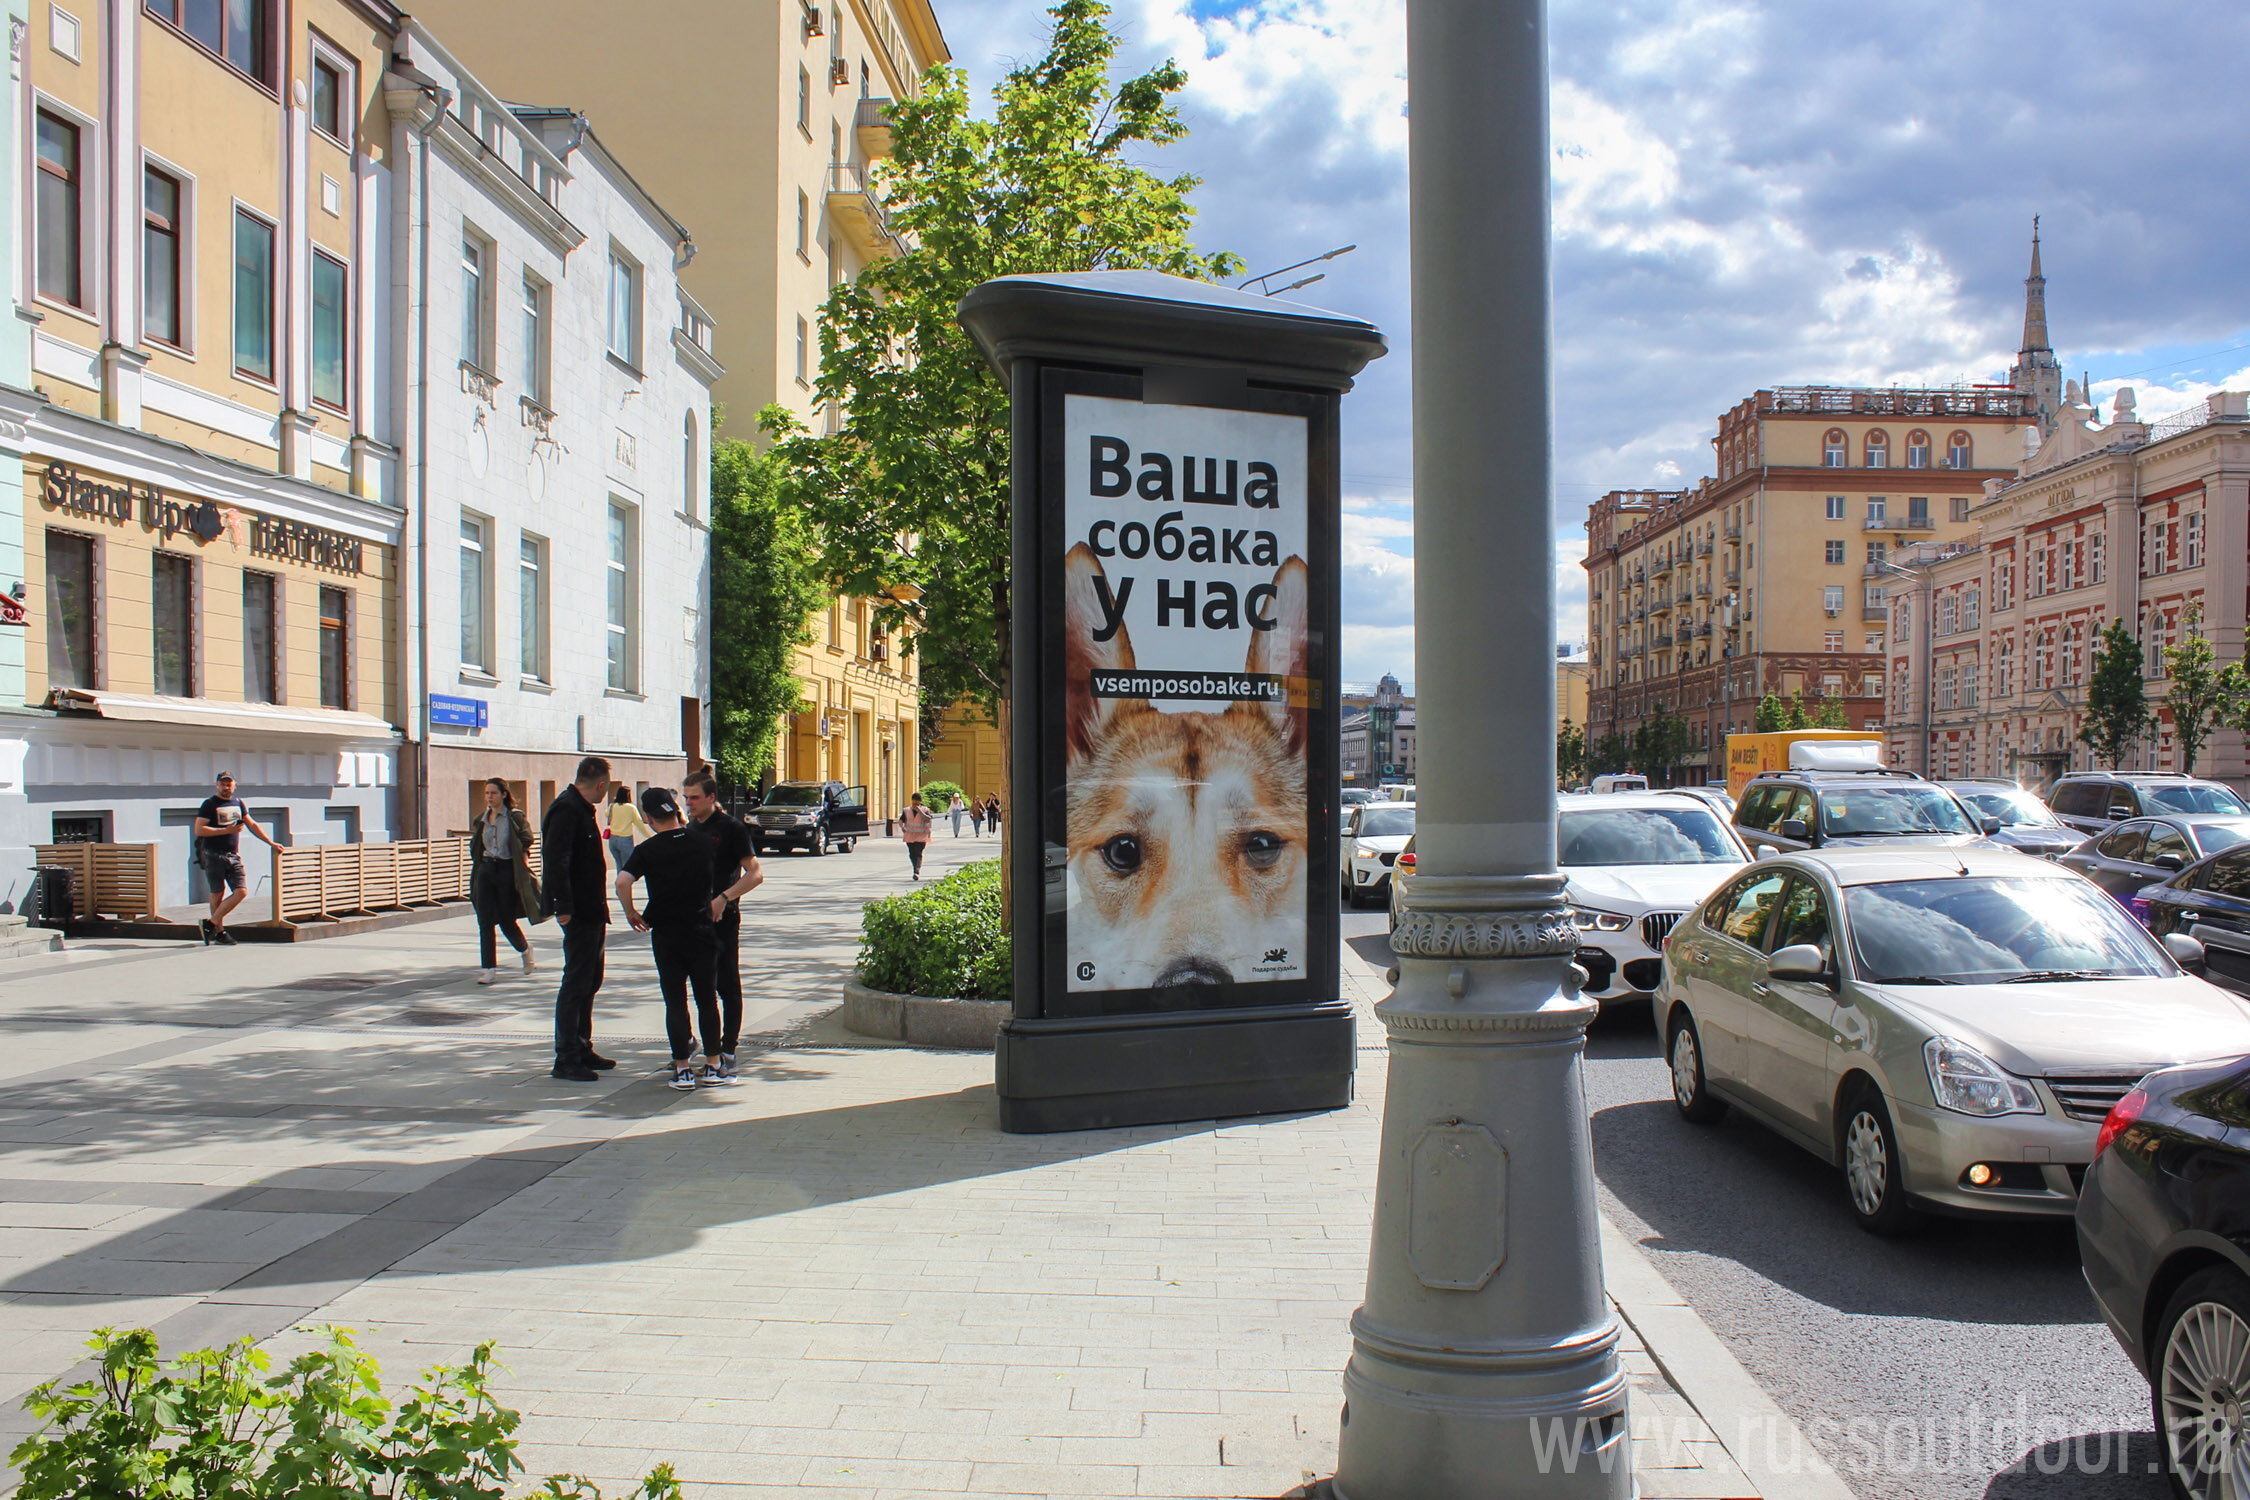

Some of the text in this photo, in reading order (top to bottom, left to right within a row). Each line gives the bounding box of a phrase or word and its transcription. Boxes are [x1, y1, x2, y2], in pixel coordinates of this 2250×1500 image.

[47, 460, 184, 541] Stand Up
[1089, 434, 1280, 510] Ваша
[257, 513, 363, 573] ПАТРИКИ
[1088, 510, 1279, 567] собака
[1090, 575, 1278, 642] у нас
[480, 708, 487, 720] 18
[1095, 675, 1280, 698] vsemposobake.ru
[1082, 965, 1096, 977] 0+
[1277, 964, 1298, 972] судьбы
